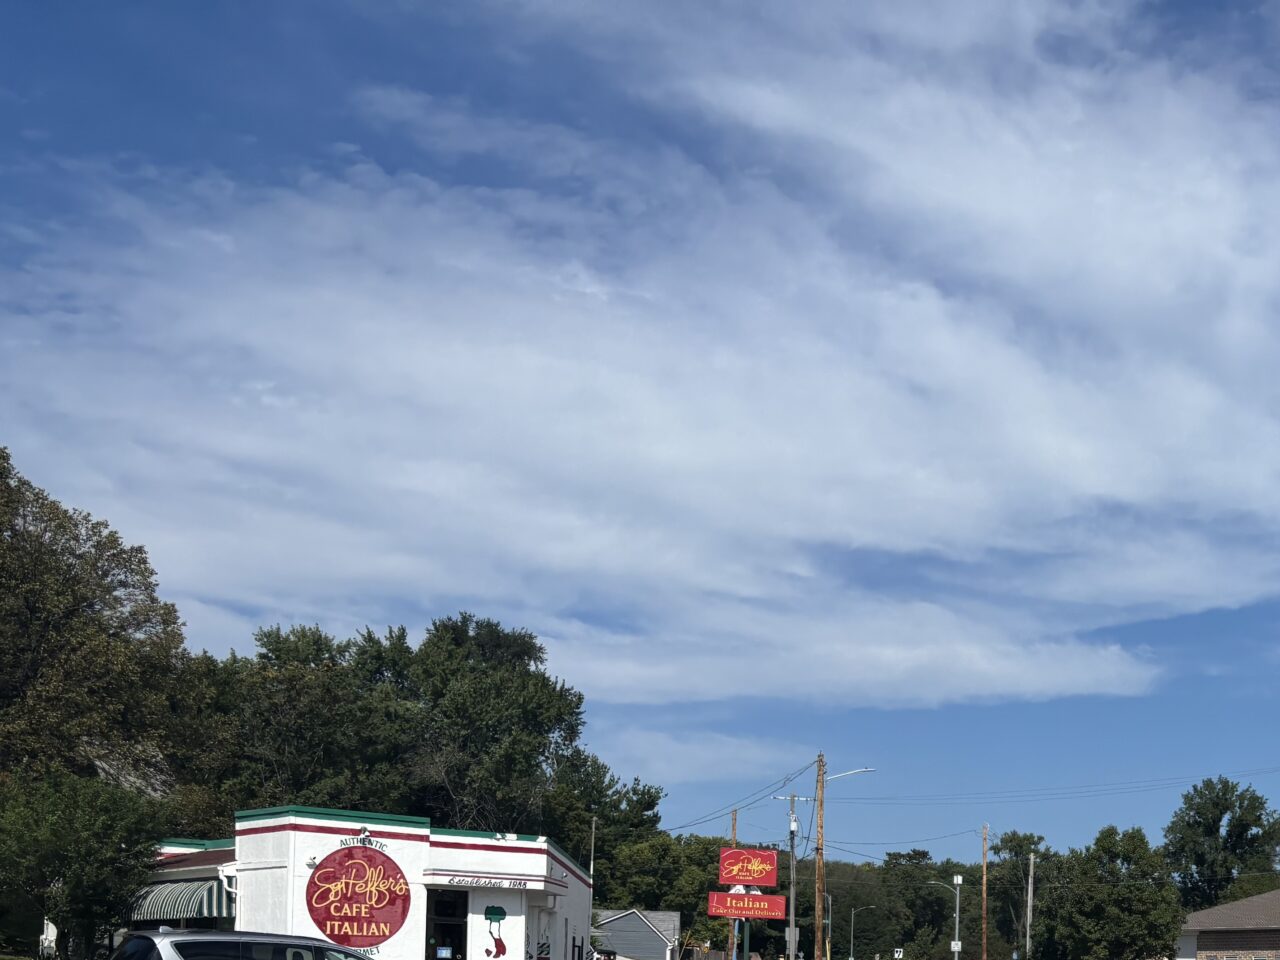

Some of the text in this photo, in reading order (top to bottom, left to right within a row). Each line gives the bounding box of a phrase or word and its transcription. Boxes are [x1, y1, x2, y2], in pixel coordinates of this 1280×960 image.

[340, 837, 388, 852] AUTHENTIC
[330, 903, 370, 917] CAFE
[726, 897, 769, 909] Italian
[326, 921, 390, 936] ITALIAN
